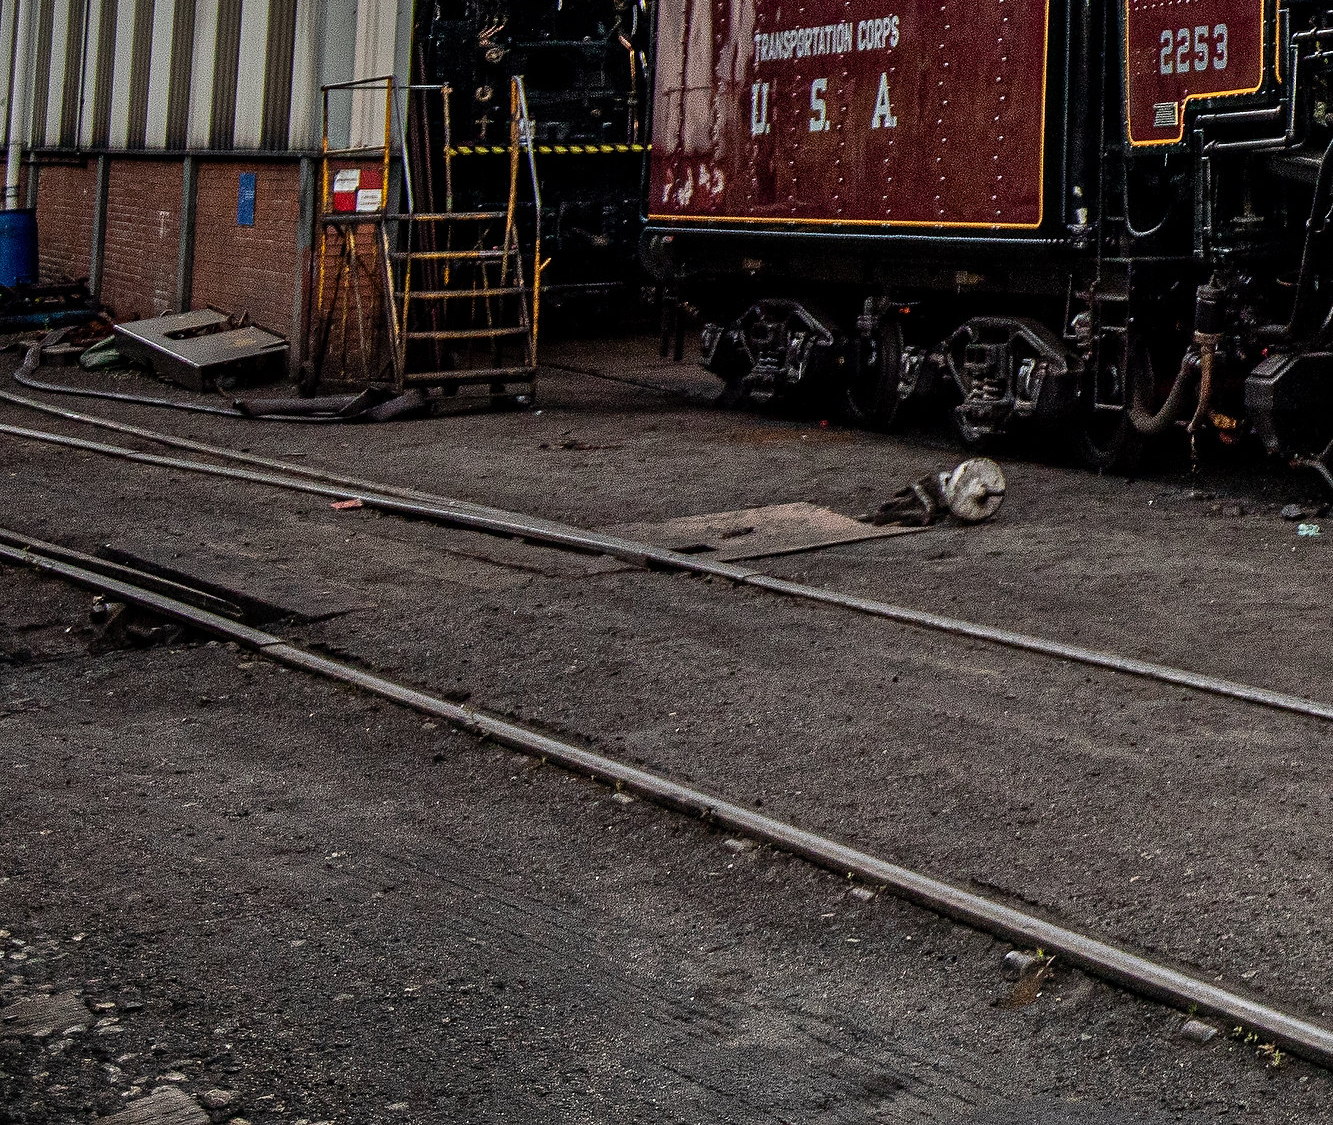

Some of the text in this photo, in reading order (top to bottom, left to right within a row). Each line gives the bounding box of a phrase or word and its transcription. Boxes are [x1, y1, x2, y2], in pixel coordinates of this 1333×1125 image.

[754, 15, 900, 62] TRANSPORTATION CORPS
[1160, 23, 1228, 75] 2253
